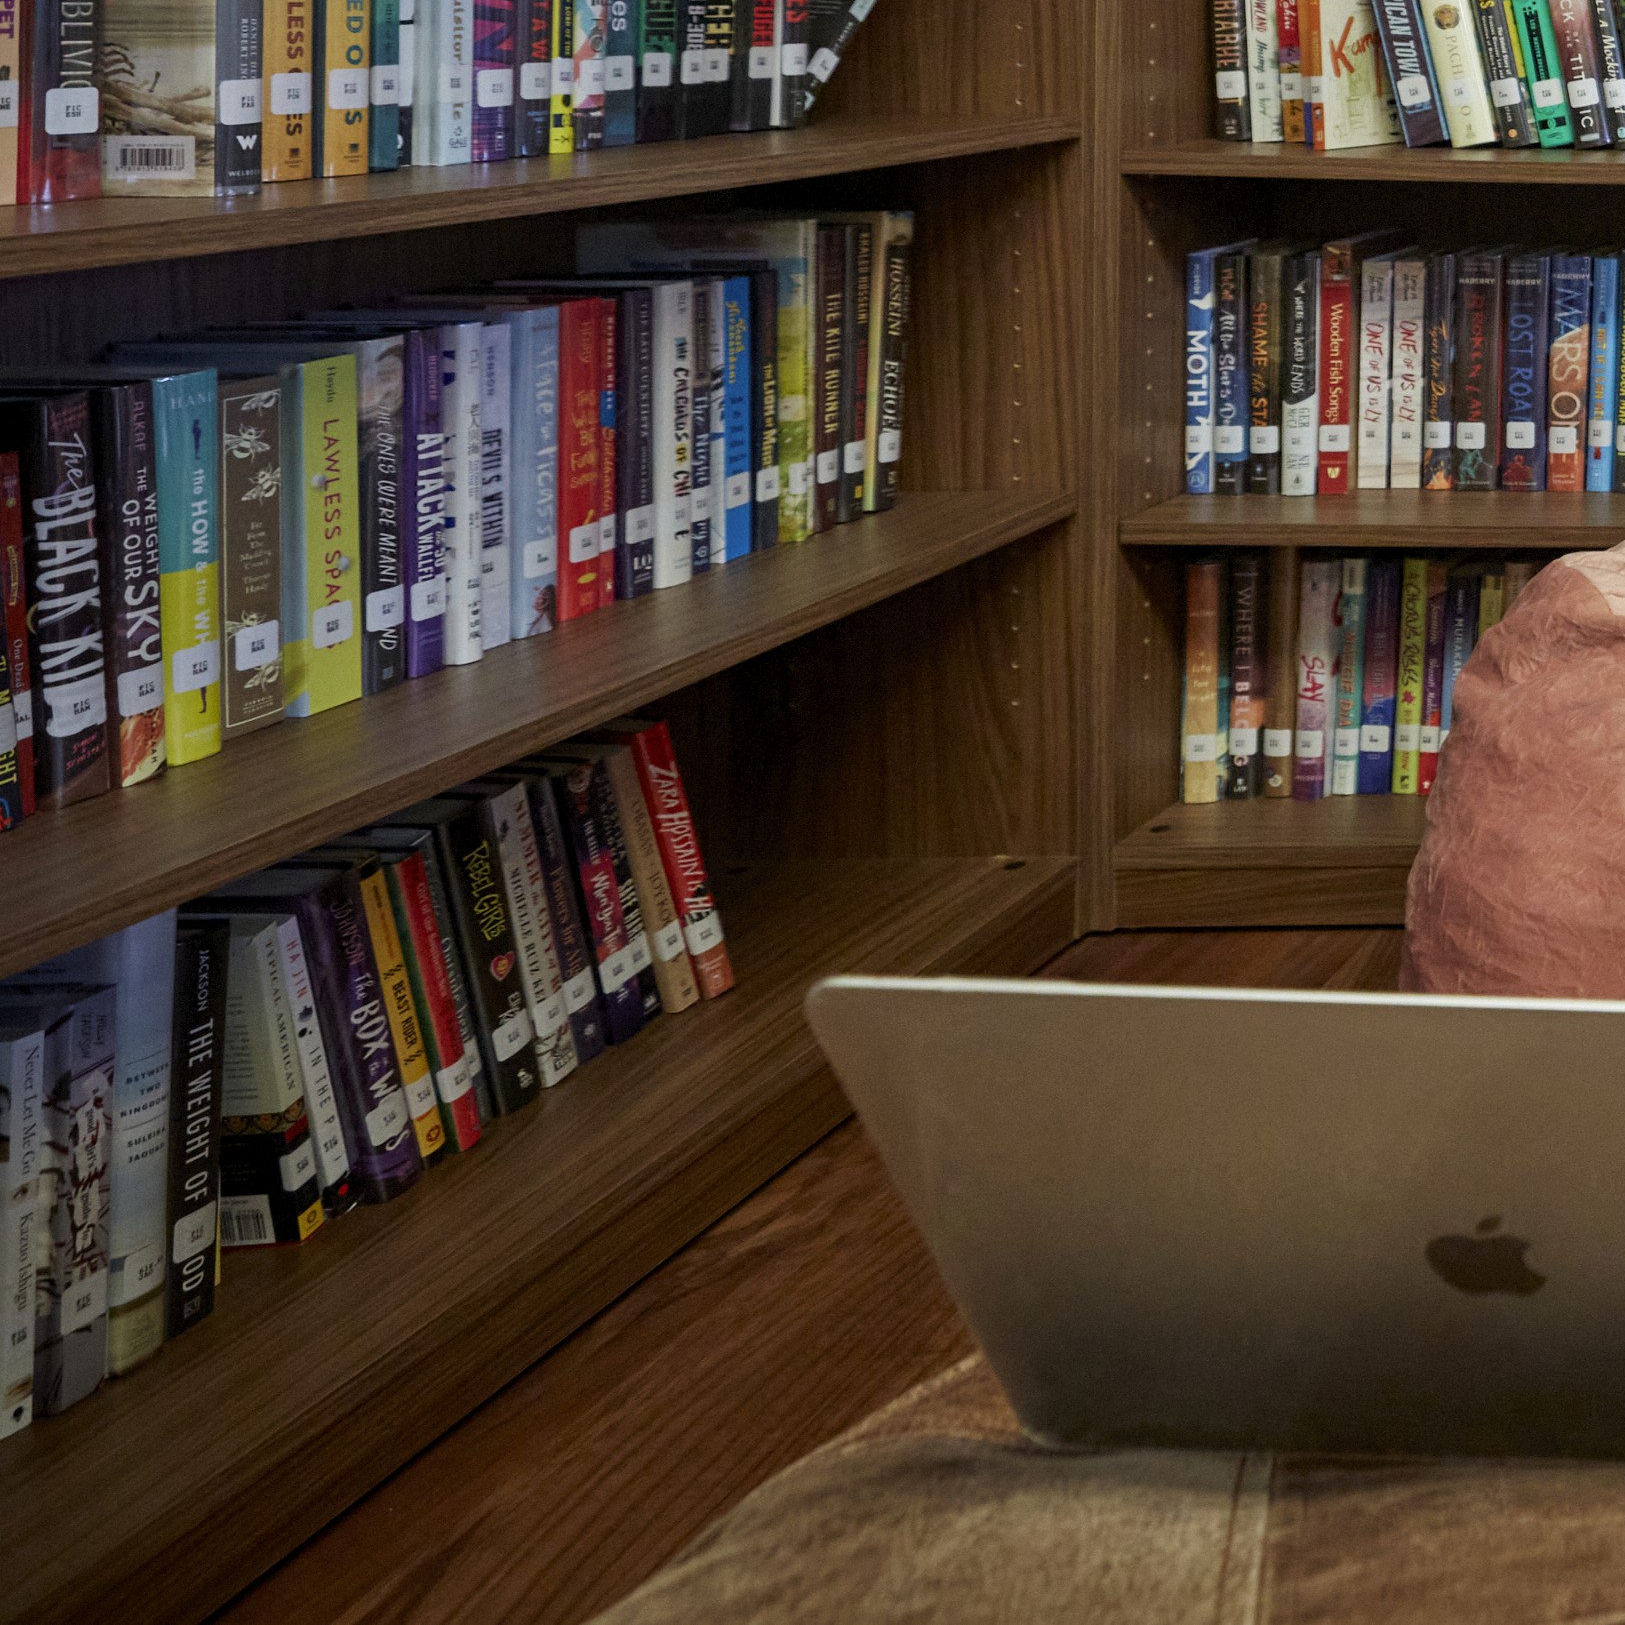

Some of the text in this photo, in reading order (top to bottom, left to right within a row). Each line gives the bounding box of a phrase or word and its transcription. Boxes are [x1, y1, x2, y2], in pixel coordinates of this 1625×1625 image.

[888, 258, 902, 336] HOSSEINI
[1253, 302, 1267, 366] SHAME
[824, 292, 840, 433] THE KITE RUNNER
[1187, 331, 1207, 406] MOTH
[1326, 303, 1343, 423] Wooden Fish Songs
[1403, 321, 1417, 352] ONE
[134, 400, 147, 492] ALKAF THE
[323, 419, 341, 540] LAWLESS
[379, 433, 396, 476] ONES
[32, 485, 101, 625] BLACK
[144, 493, 158, 575] WEIGHT
[192, 500, 209, 554] HOW
[123, 499, 160, 662] OF OUR SKY
[1235, 586, 1250, 656] WHERE
[1300, 656, 1324, 705] SLAY
[648, 762, 678, 807] ZARA
[350, 999, 385, 1060] BOX
[393, 981, 417, 1049] BEAST RIDER
[22, 1047, 39, 1175] Never Let Me Go
[184, 949, 214, 1202] JACKSON THE WEIGHT OF
